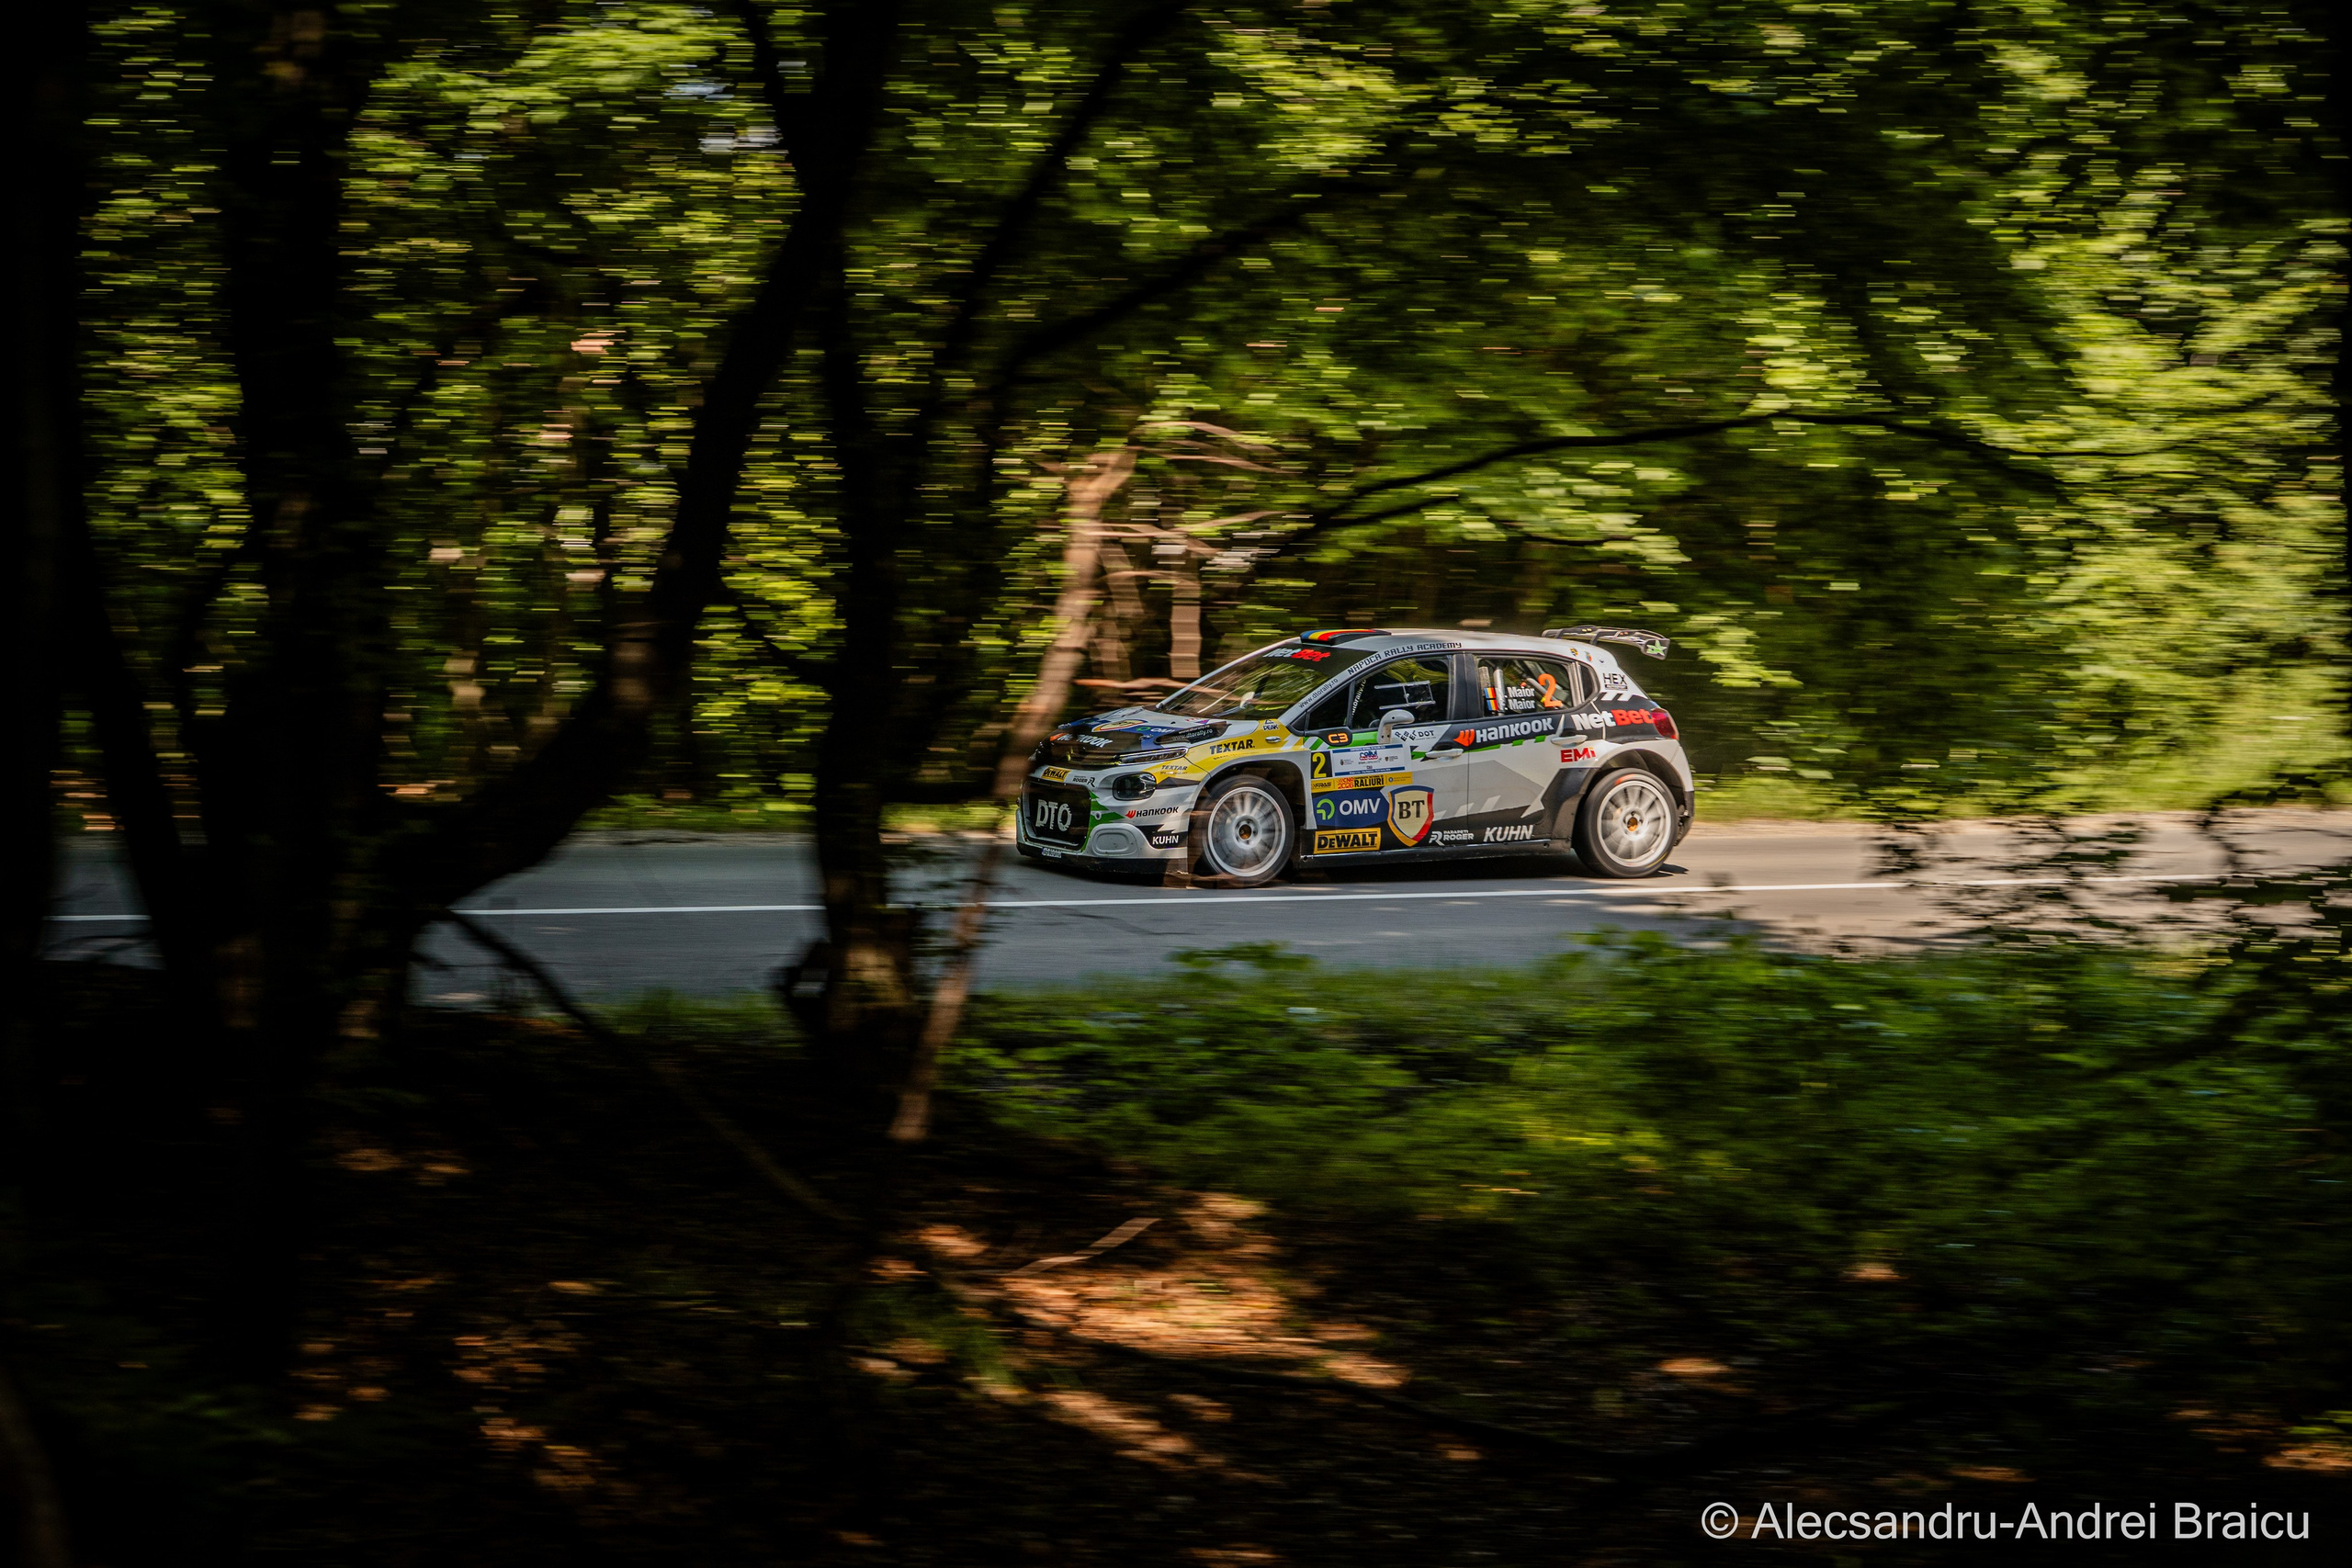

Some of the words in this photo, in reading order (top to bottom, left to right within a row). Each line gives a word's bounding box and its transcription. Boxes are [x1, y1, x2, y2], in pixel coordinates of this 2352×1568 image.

[1347, 653, 1382, 675] NAPOCA
[1384, 645, 1414, 658] RALLY
[1417, 642, 1462, 651] ACADEMY
[1602, 672, 1627, 685] HEX
[1298, 678, 1339, 708] www.dtorally.ro
[1507, 686, 1535, 698] Maior
[1538, 673, 1562, 707] 2
[1507, 698, 1535, 710] Maior
[1570, 708, 1654, 731] NetBet
[1328, 732, 1349, 744] C3
[1418, 729, 1434, 738] DOT
[1312, 752, 1327, 778] 2
[1354, 777, 1384, 788] RALIURI
[1035, 798, 1072, 831] DTO
[1339, 797, 1381, 816] OMV
[1397, 799, 1425, 819] BT
[1152, 835, 1180, 845] KUHN
[1443, 833, 1475, 841] ROGER
[1483, 824, 1533, 842] KUHN
